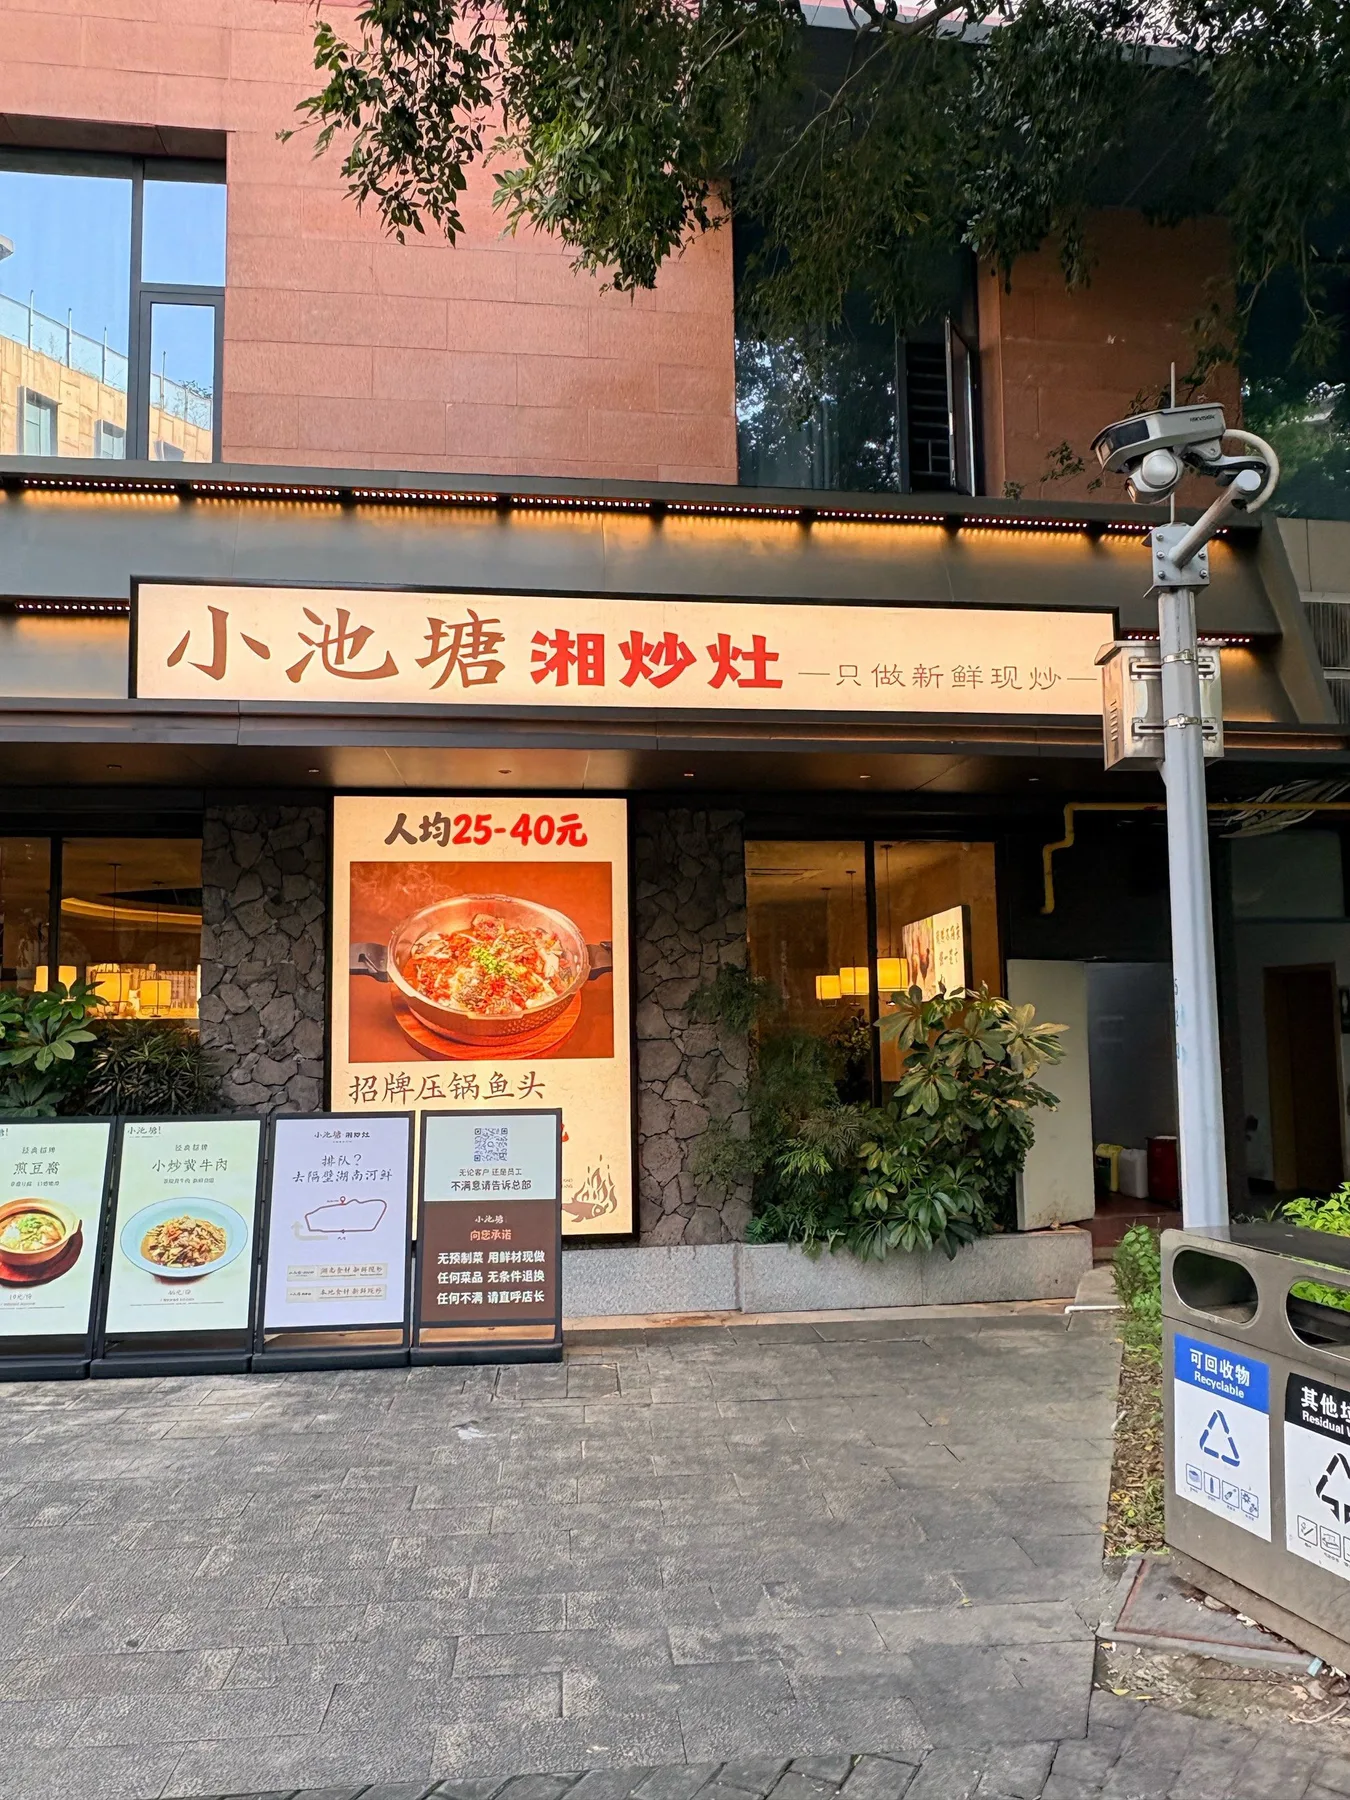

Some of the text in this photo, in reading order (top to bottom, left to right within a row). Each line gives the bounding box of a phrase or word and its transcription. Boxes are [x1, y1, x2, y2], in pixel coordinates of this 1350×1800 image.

[166, 605, 784, 690] 小池塘 湘炒灶
[836, 663, 1062, 690] 只做新鲜现炒
[348, 1070, 546, 1105] 招牌压锅鱼头
[13, 1161, 60, 1175] 煎豆腐
[152, 1158, 228, 1173] 小炒黄牛肉
[459, 1167, 523, 1177] 无论客户 还是员工
[292, 1168, 393, 1183] 去隔壁湖南河鲜
[451, 1179, 532, 1191] 不满意请告诉总部
[470, 1229, 512, 1241] 向您承诺
[437, 1250, 546, 1265] 无预制菜 用鲜材现做
[437, 1269, 545, 1285] 任何菜品 无条件退换
[436, 1290, 545, 1305] 任何不满 请直呼店长
[1190, 1348, 1250, 1387] 可回收物
[1194, 1370, 1245, 1399] Recyclable
[1302, 1410, 1345, 1435] Residual
